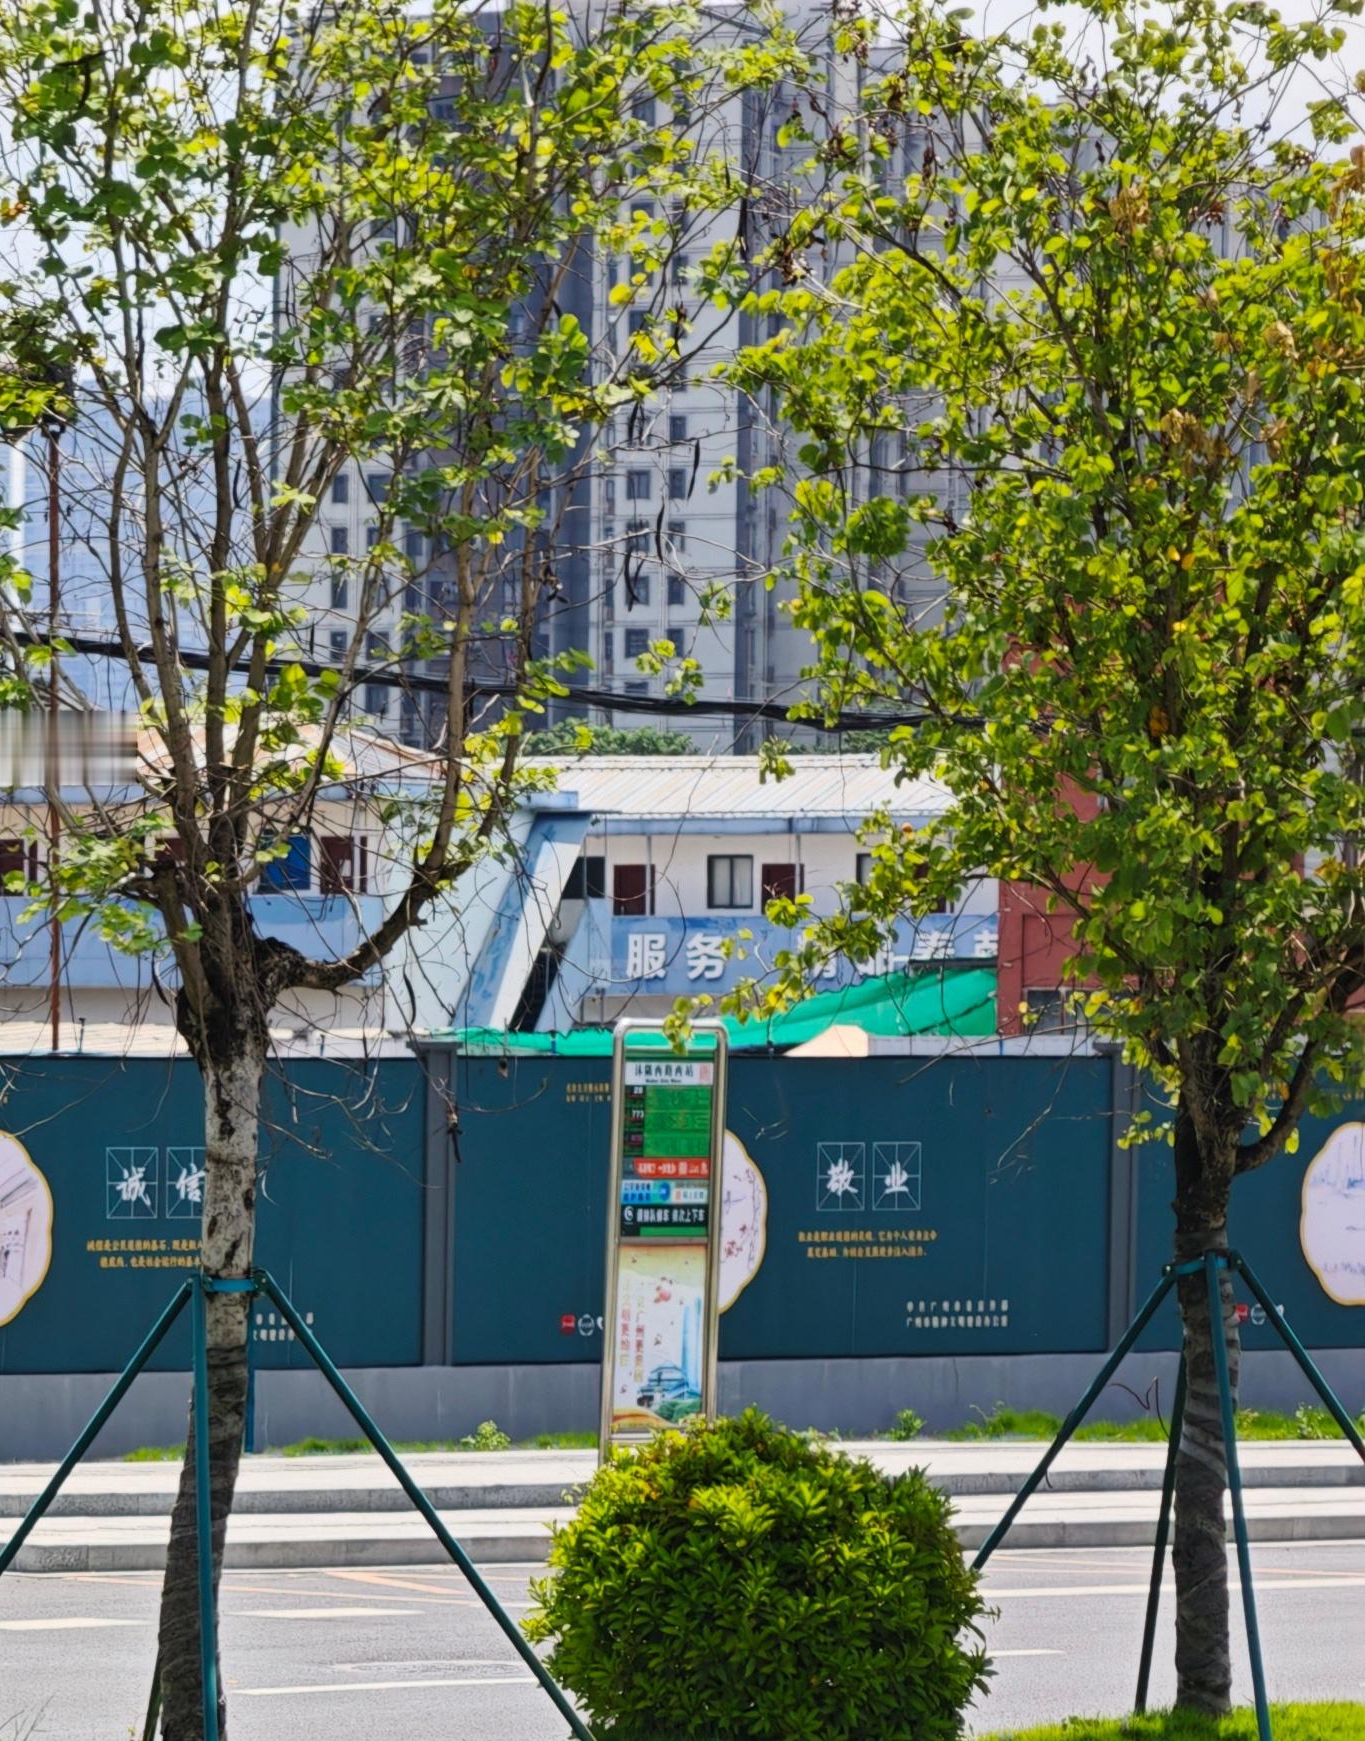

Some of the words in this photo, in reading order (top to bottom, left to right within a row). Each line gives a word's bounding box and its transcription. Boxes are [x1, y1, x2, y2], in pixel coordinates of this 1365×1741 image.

[631, 1109, 645, 1119] 773
[115, 1162, 206, 1207] 诚信
[826, 1157, 910, 1197] 敬业
